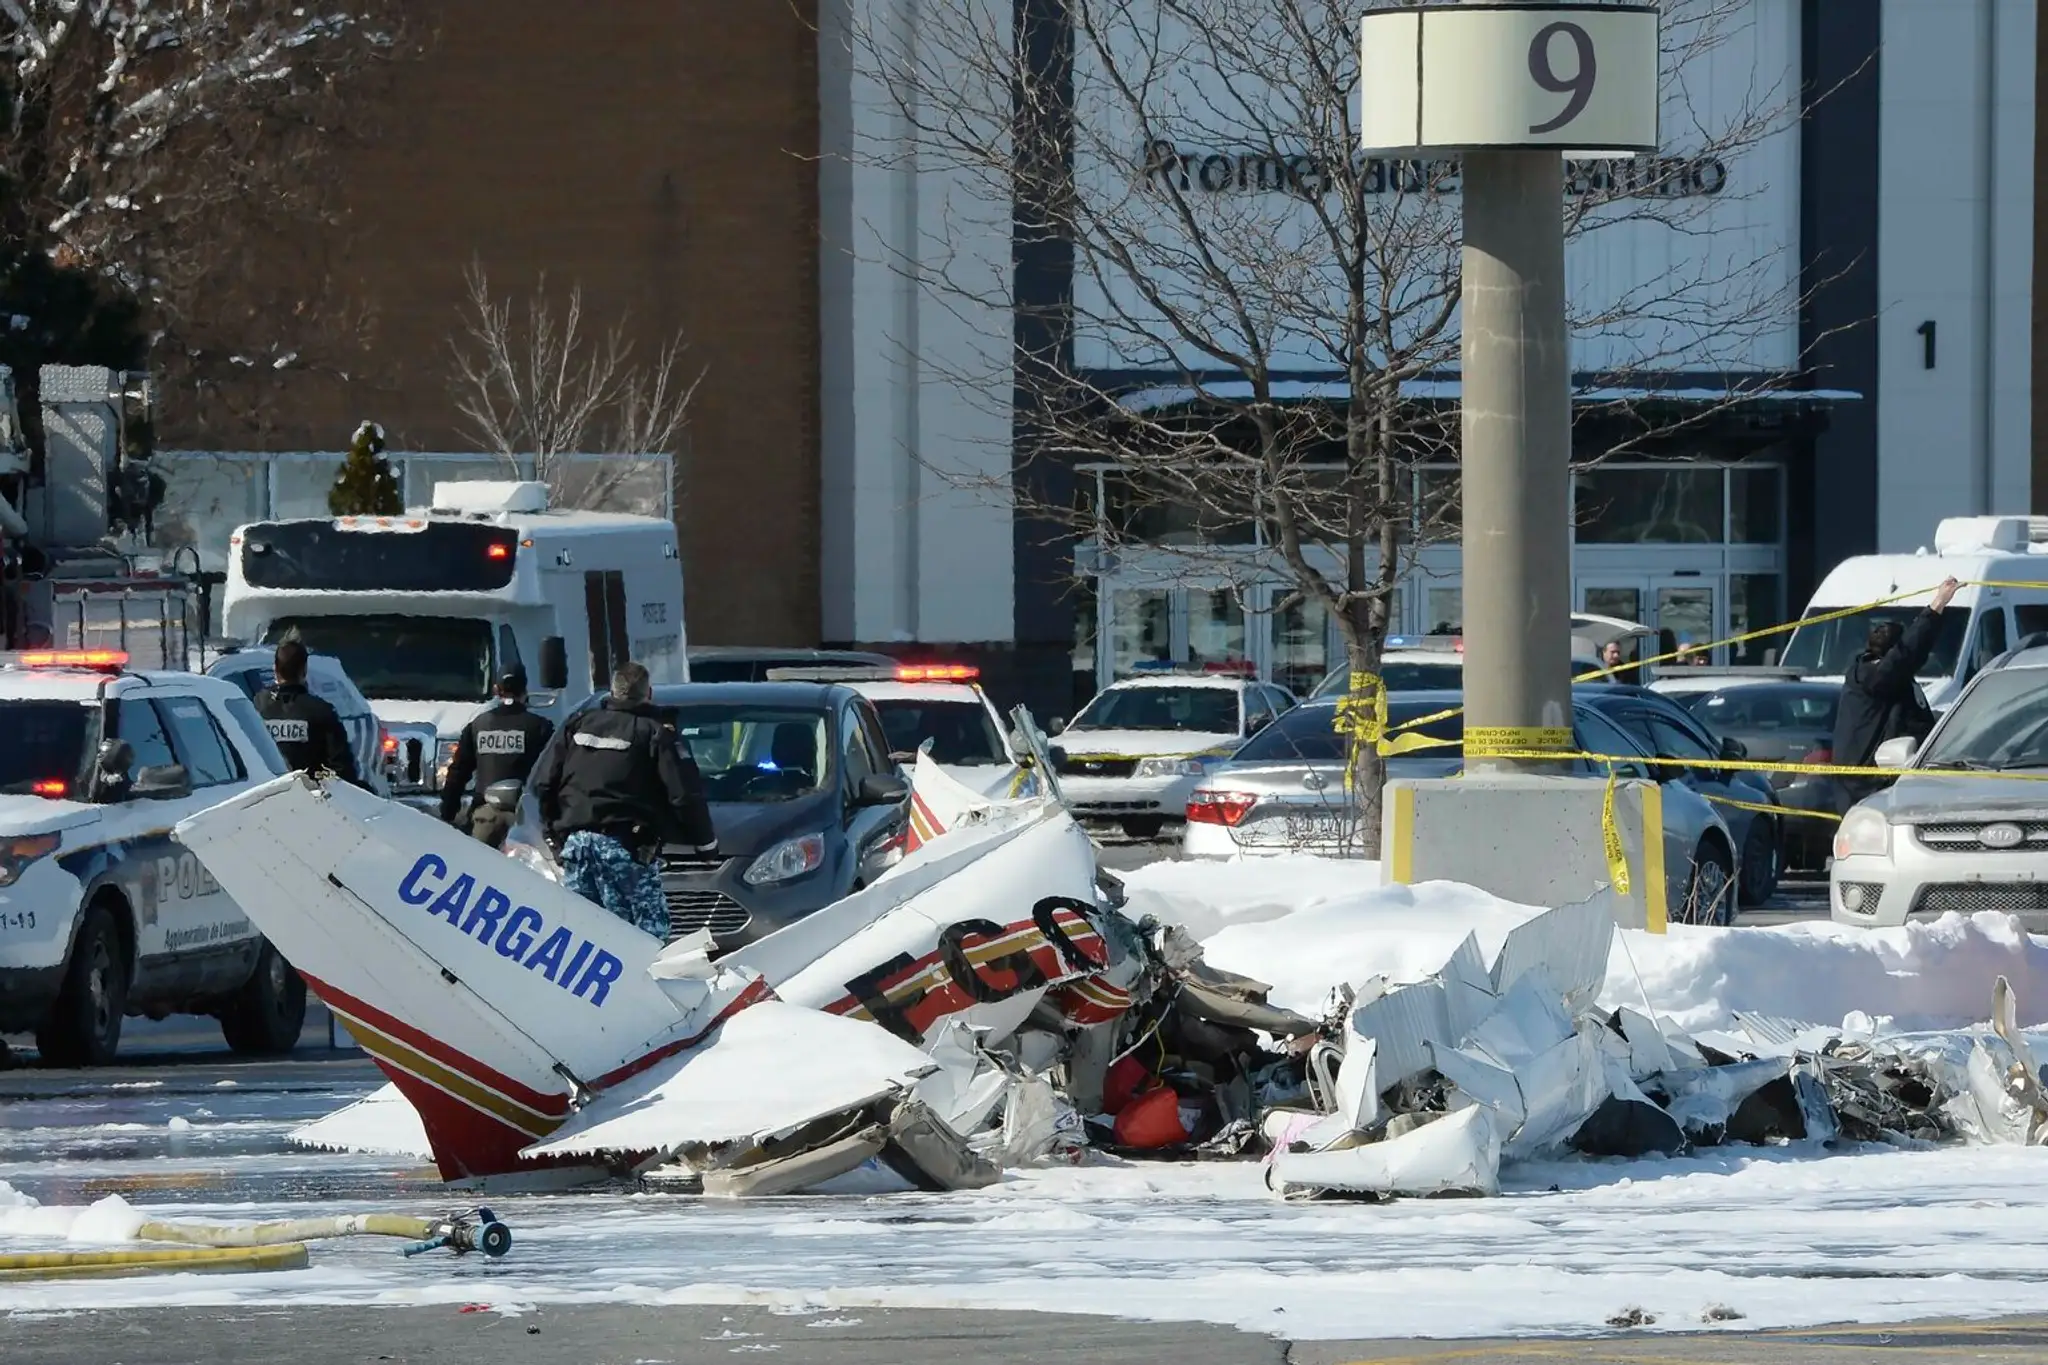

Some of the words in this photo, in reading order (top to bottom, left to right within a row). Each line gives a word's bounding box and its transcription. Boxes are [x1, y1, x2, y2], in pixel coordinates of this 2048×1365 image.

[1528, 21, 1596, 134] 9
[1917, 320, 1936, 370] 1
[479, 735, 523, 749] POLICE
[1987, 828, 2014, 840] KIA
[398, 853, 623, 1008] CARGAIR
